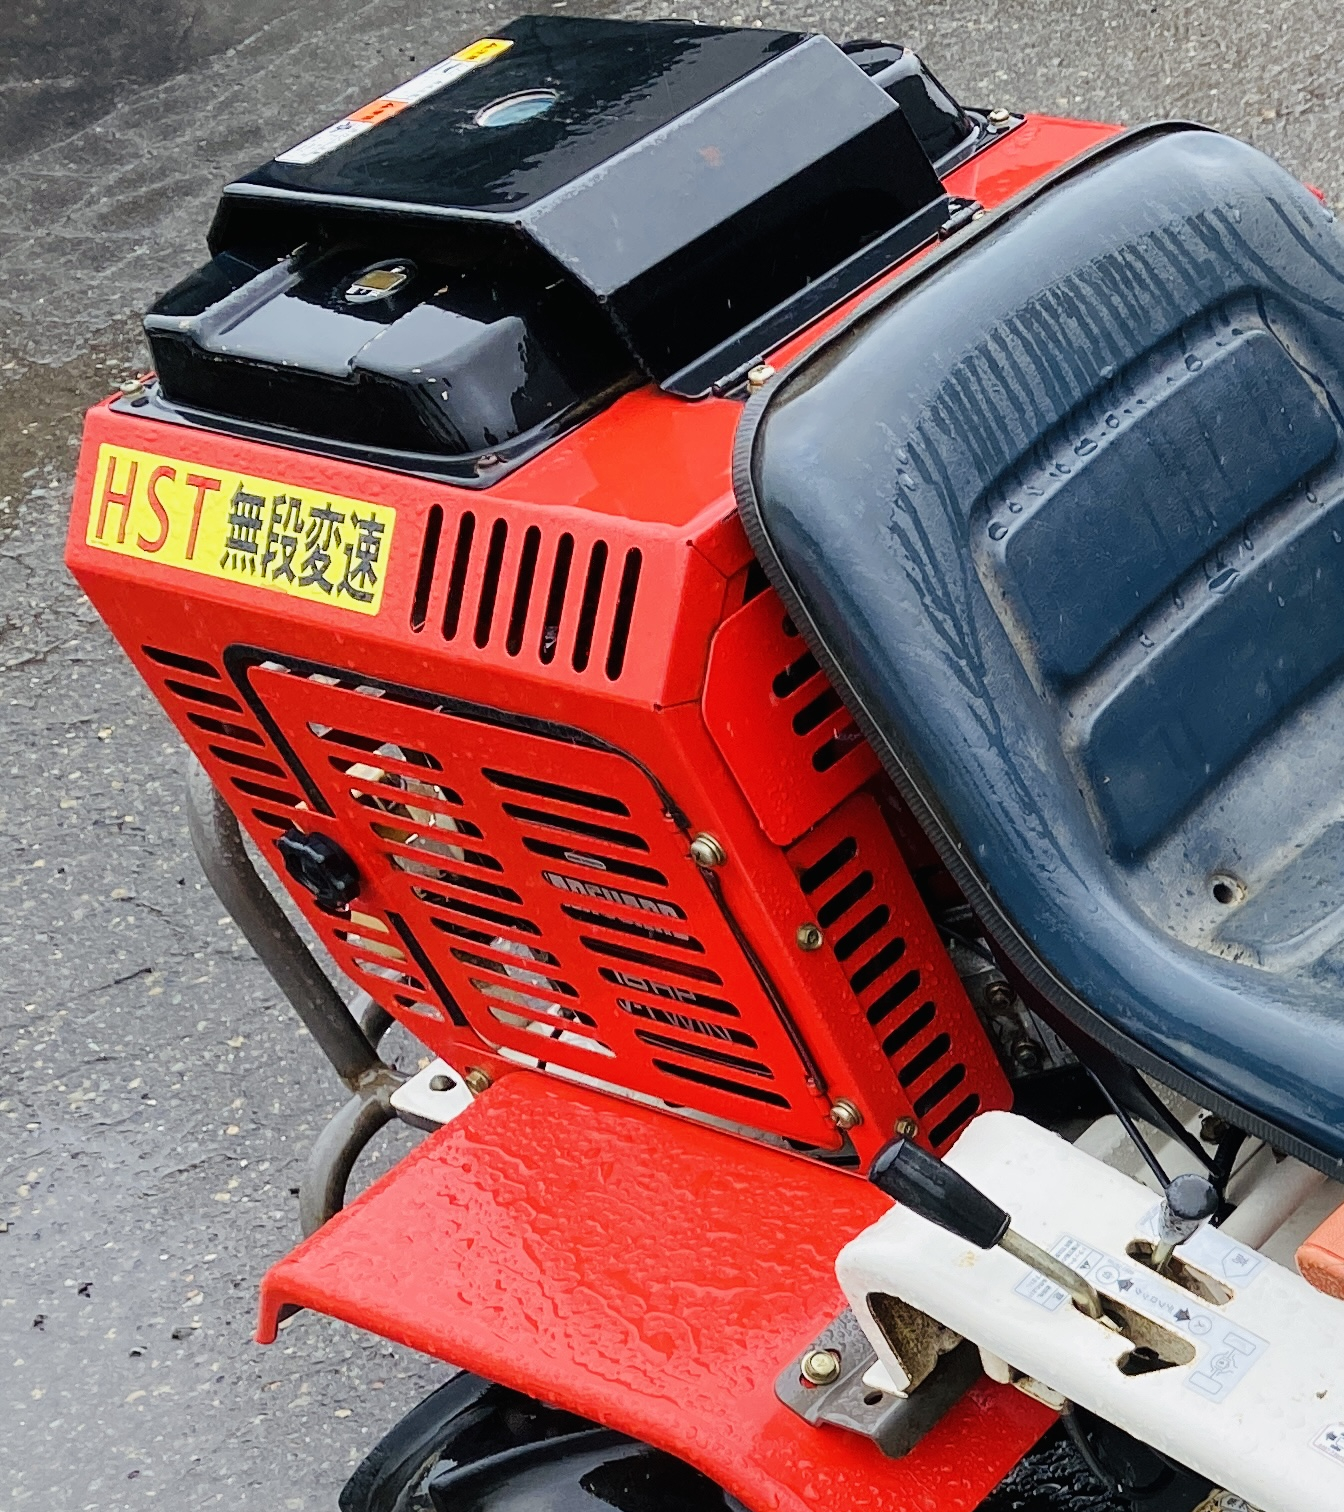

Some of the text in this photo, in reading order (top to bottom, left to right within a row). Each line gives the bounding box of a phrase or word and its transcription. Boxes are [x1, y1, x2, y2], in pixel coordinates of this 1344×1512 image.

[94, 456, 388, 606] HST 無段変速
